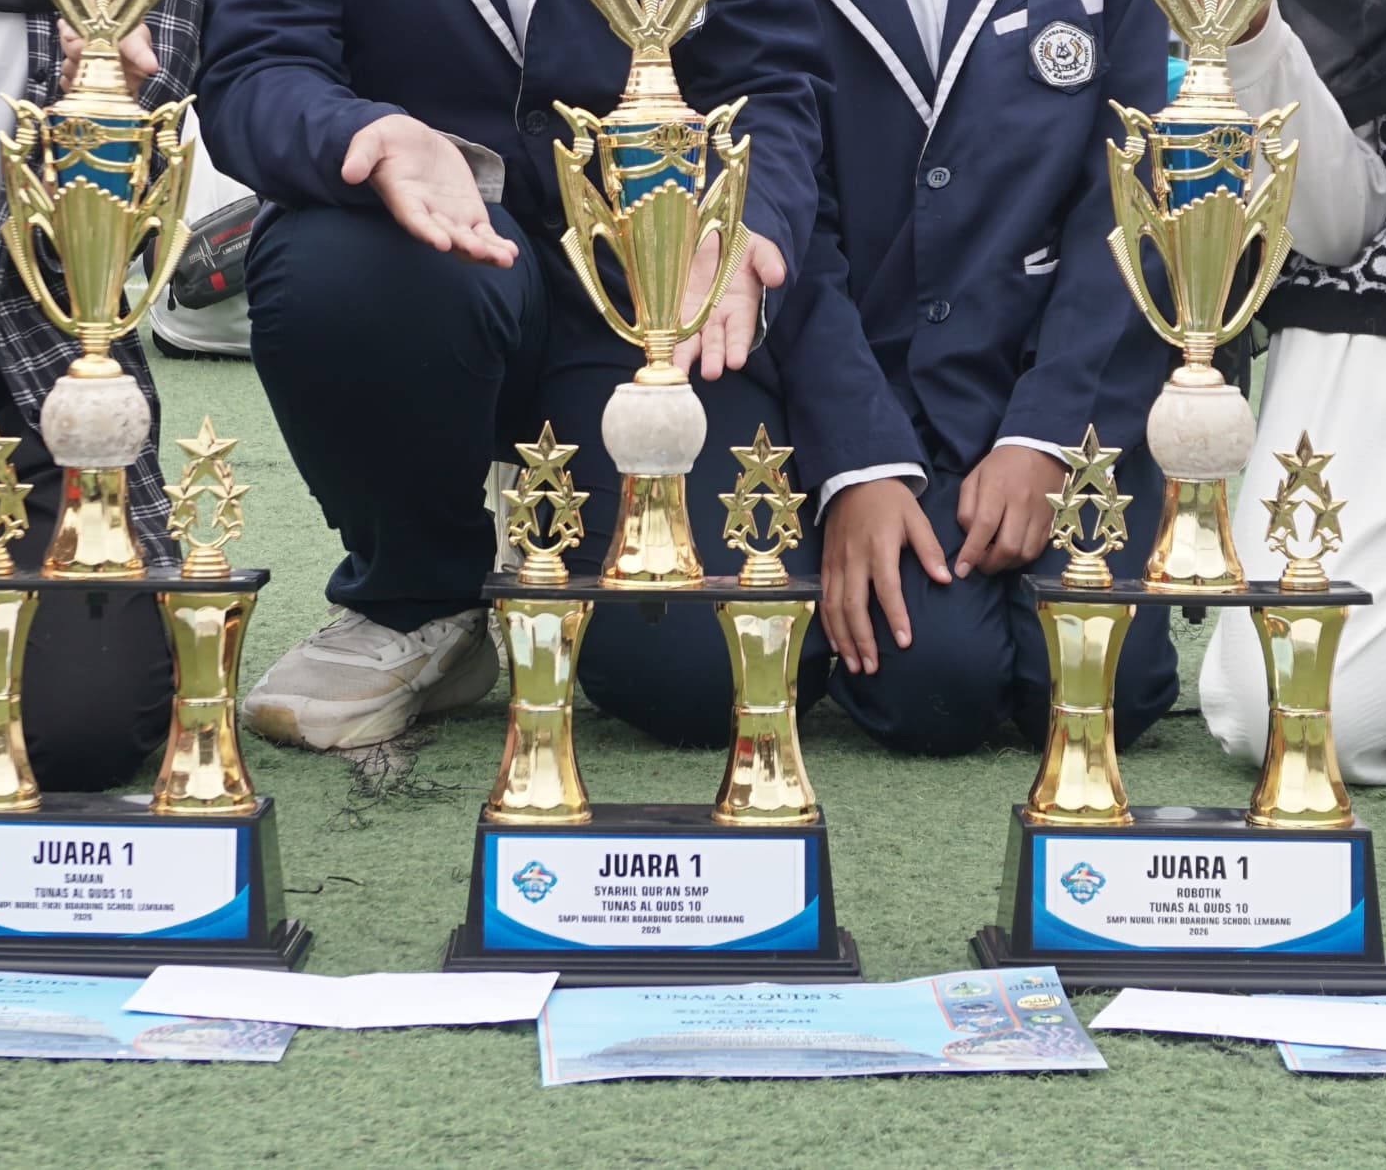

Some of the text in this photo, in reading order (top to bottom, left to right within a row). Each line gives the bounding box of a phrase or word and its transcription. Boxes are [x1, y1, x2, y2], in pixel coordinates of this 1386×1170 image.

[32, 840, 134, 867] JUARA 1
[598, 853, 702, 879] JUARA 1
[1146, 854, 1249, 881] JUARA 1
[64, 872, 104, 885] SAMAN
[594, 885, 710, 898] SYARHIL QUR'AN SMP
[1176, 887, 1222, 899] ROBOTIK
[601, 900, 702, 912] TUNAS AL QUDS 10
[1149, 901, 1249, 915] TUNAS AL QUDS 10
[557, 914, 745, 924] SMPI NURUL FIKRI BOARDING SCHOOL LEMBANG
[1106, 915, 1292, 926] SMPI NURUL FIKRI BOARDING SCHOOL LEMBANG
